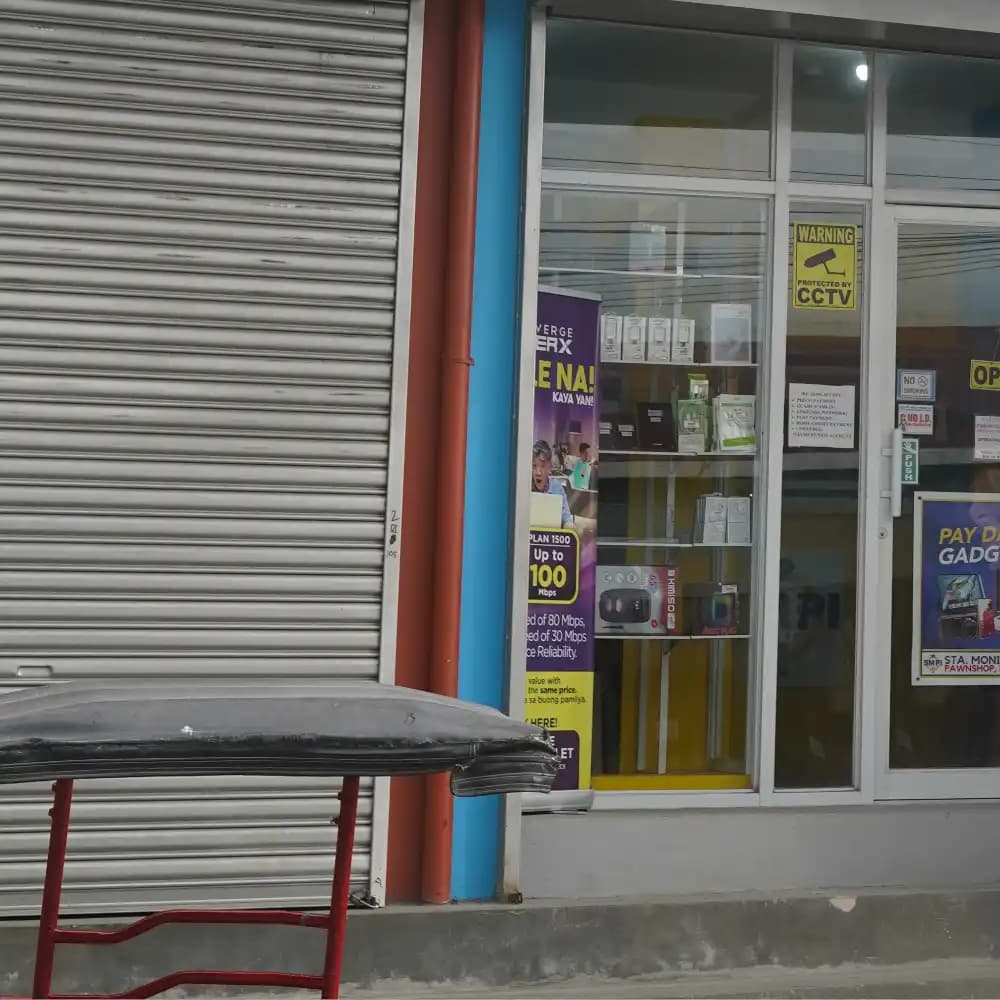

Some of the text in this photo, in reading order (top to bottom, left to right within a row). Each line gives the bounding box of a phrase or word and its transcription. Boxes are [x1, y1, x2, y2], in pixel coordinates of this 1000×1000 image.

[798, 225, 854, 243] WARNING
[798, 280, 840, 288] PROTECTED
[797, 287, 852, 305] CCTV
[556, 361, 595, 393] NA!
[904, 376, 915, 385] NO
[552, 391, 574, 404] KAYA
[904, 454, 913, 481] PUSH
[529, 534, 570, 544] PLAN 1500
[939, 527, 977, 545] PAY
[534, 548, 564, 562] Up to
[529, 564, 567, 588] 100
[538, 589, 557, 597] Mbps
[537, 614, 547, 626] of
[548, 614, 560, 626] 80
[561, 614, 585, 629] Mbps,
[540, 629, 550, 642] of
[551, 630, 562, 642] 30
[564, 630, 587, 645] Mbps
[538, 646, 577, 660] Reliability.
[944, 656, 968, 665] STA.
[944, 665, 996, 673] PAWNSHOP,
[528, 677, 561, 685] value with
[559, 686, 577, 695] price.
[531, 717, 558, 728] HERE!
